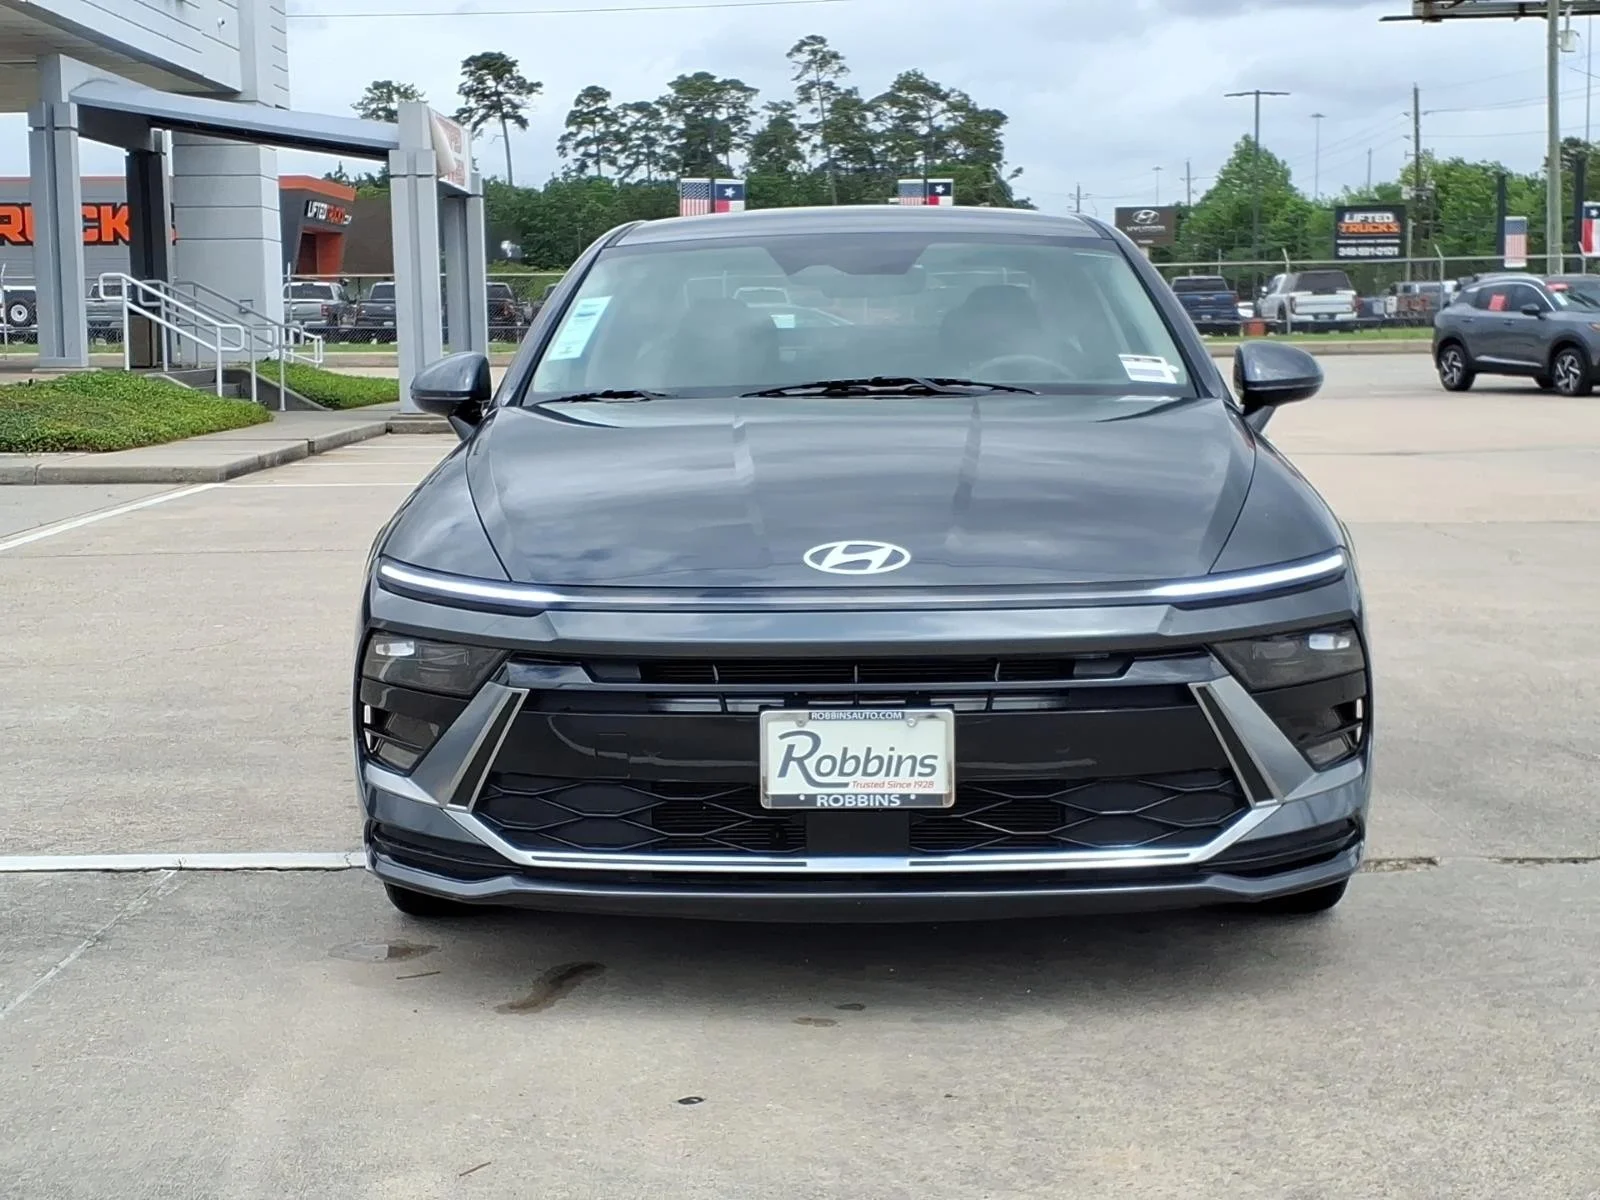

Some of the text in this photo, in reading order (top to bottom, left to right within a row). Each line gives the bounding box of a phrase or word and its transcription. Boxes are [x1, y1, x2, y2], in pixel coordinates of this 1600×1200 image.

[1344, 212, 1395, 223] LIFTED
[1339, 223, 1401, 235] TRUCKS
[811, 711, 903, 720] ROBBINSAUTO.COM
[777, 730, 939, 789] Robbins
[852, 780, 935, 789] Trusted Since 1928
[816, 794, 901, 807] ROBBINS
